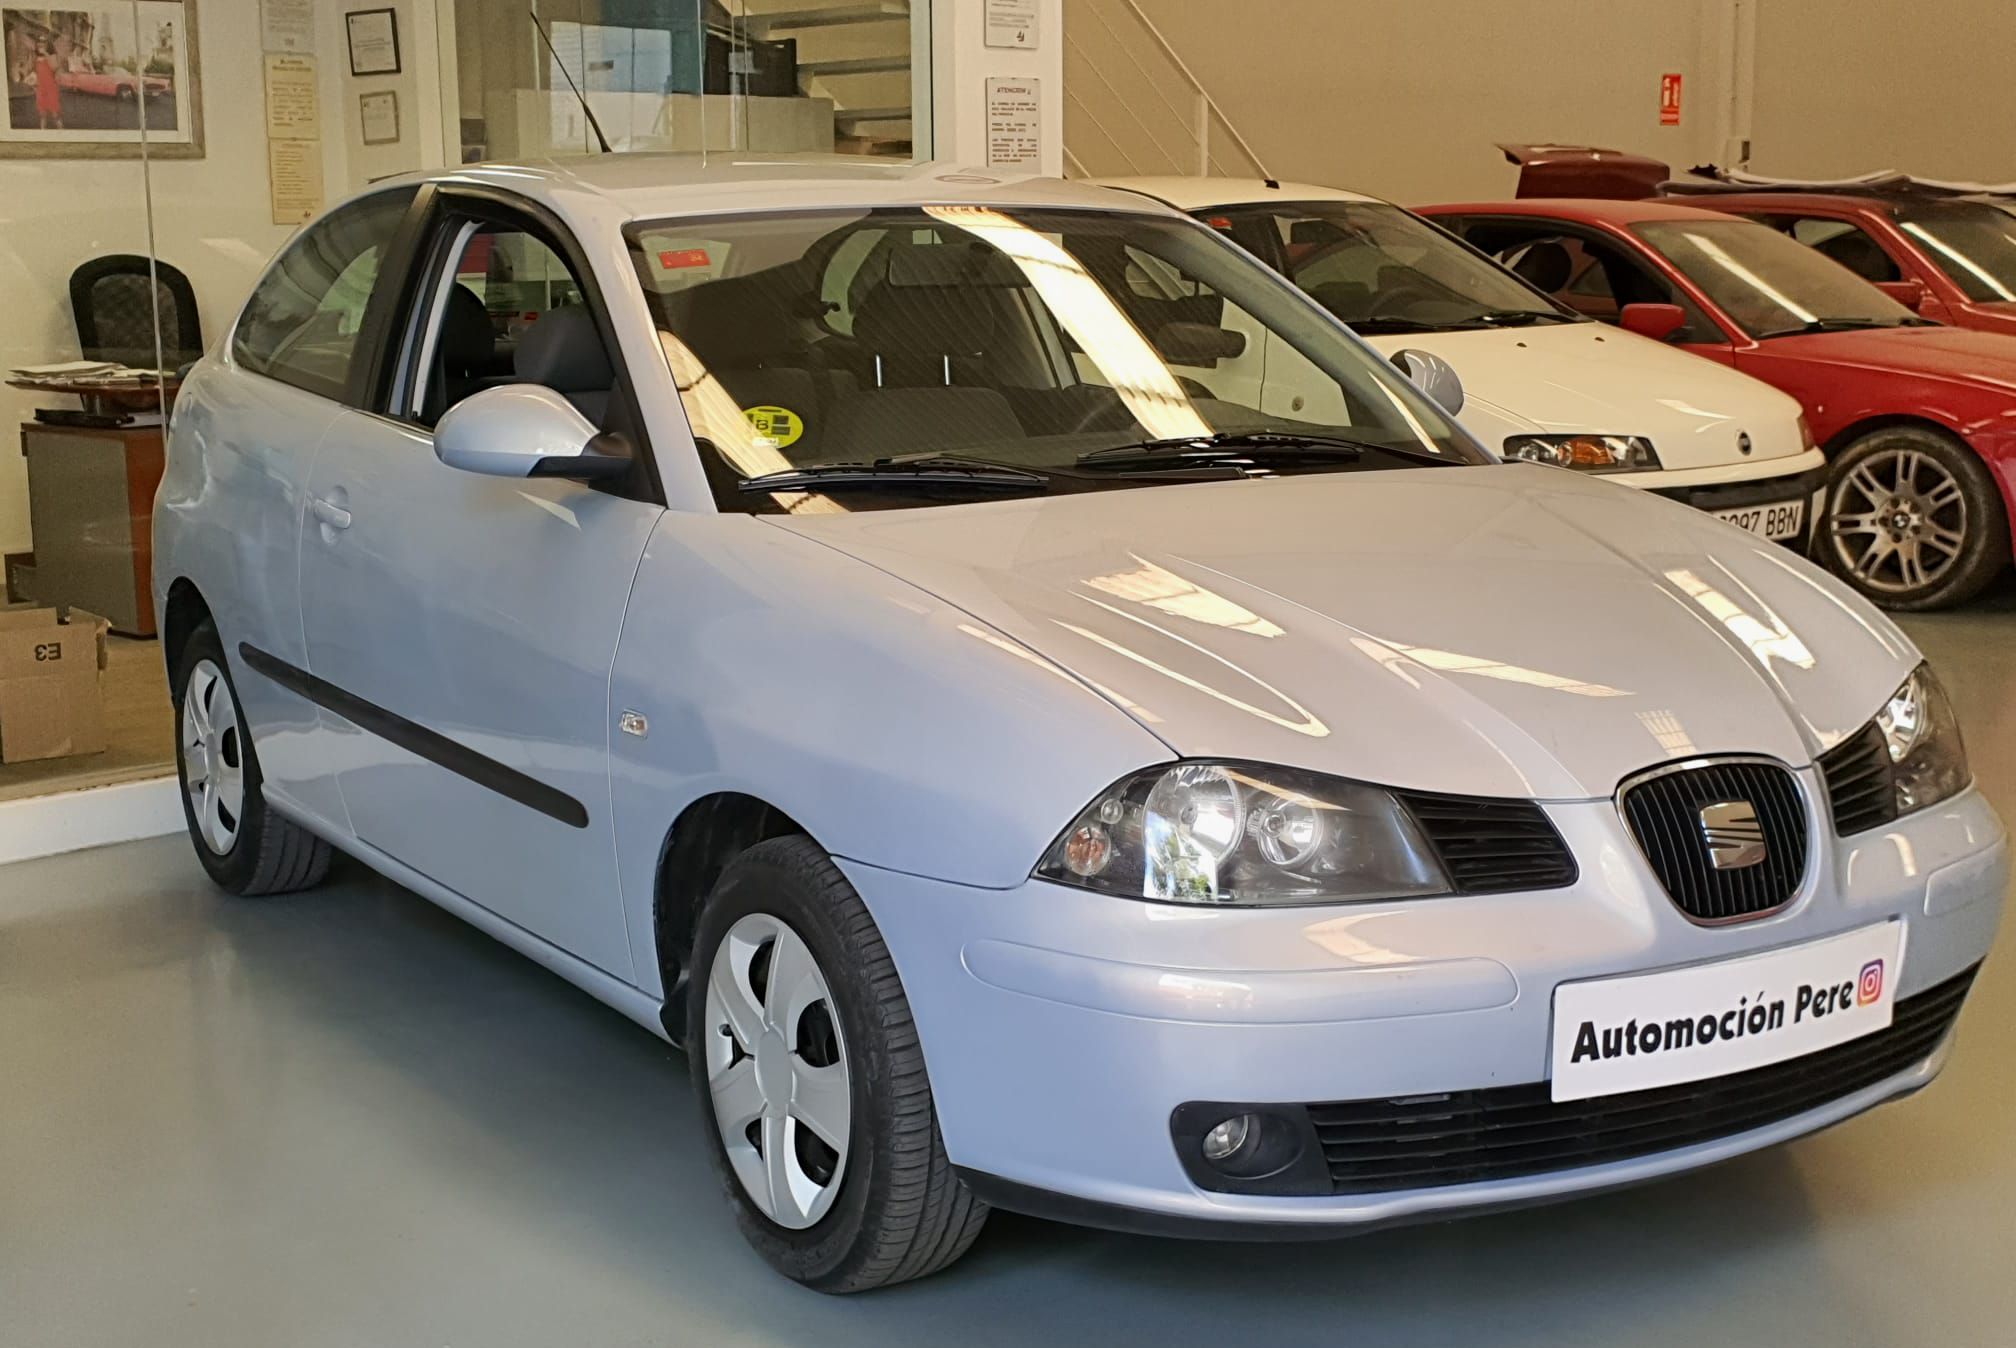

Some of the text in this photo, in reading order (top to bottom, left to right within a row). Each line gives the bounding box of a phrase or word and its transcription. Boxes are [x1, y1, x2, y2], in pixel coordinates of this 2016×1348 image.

[1766, 506, 1799, 536] BBN
[1570, 981, 1854, 1064] Automoción Pere
